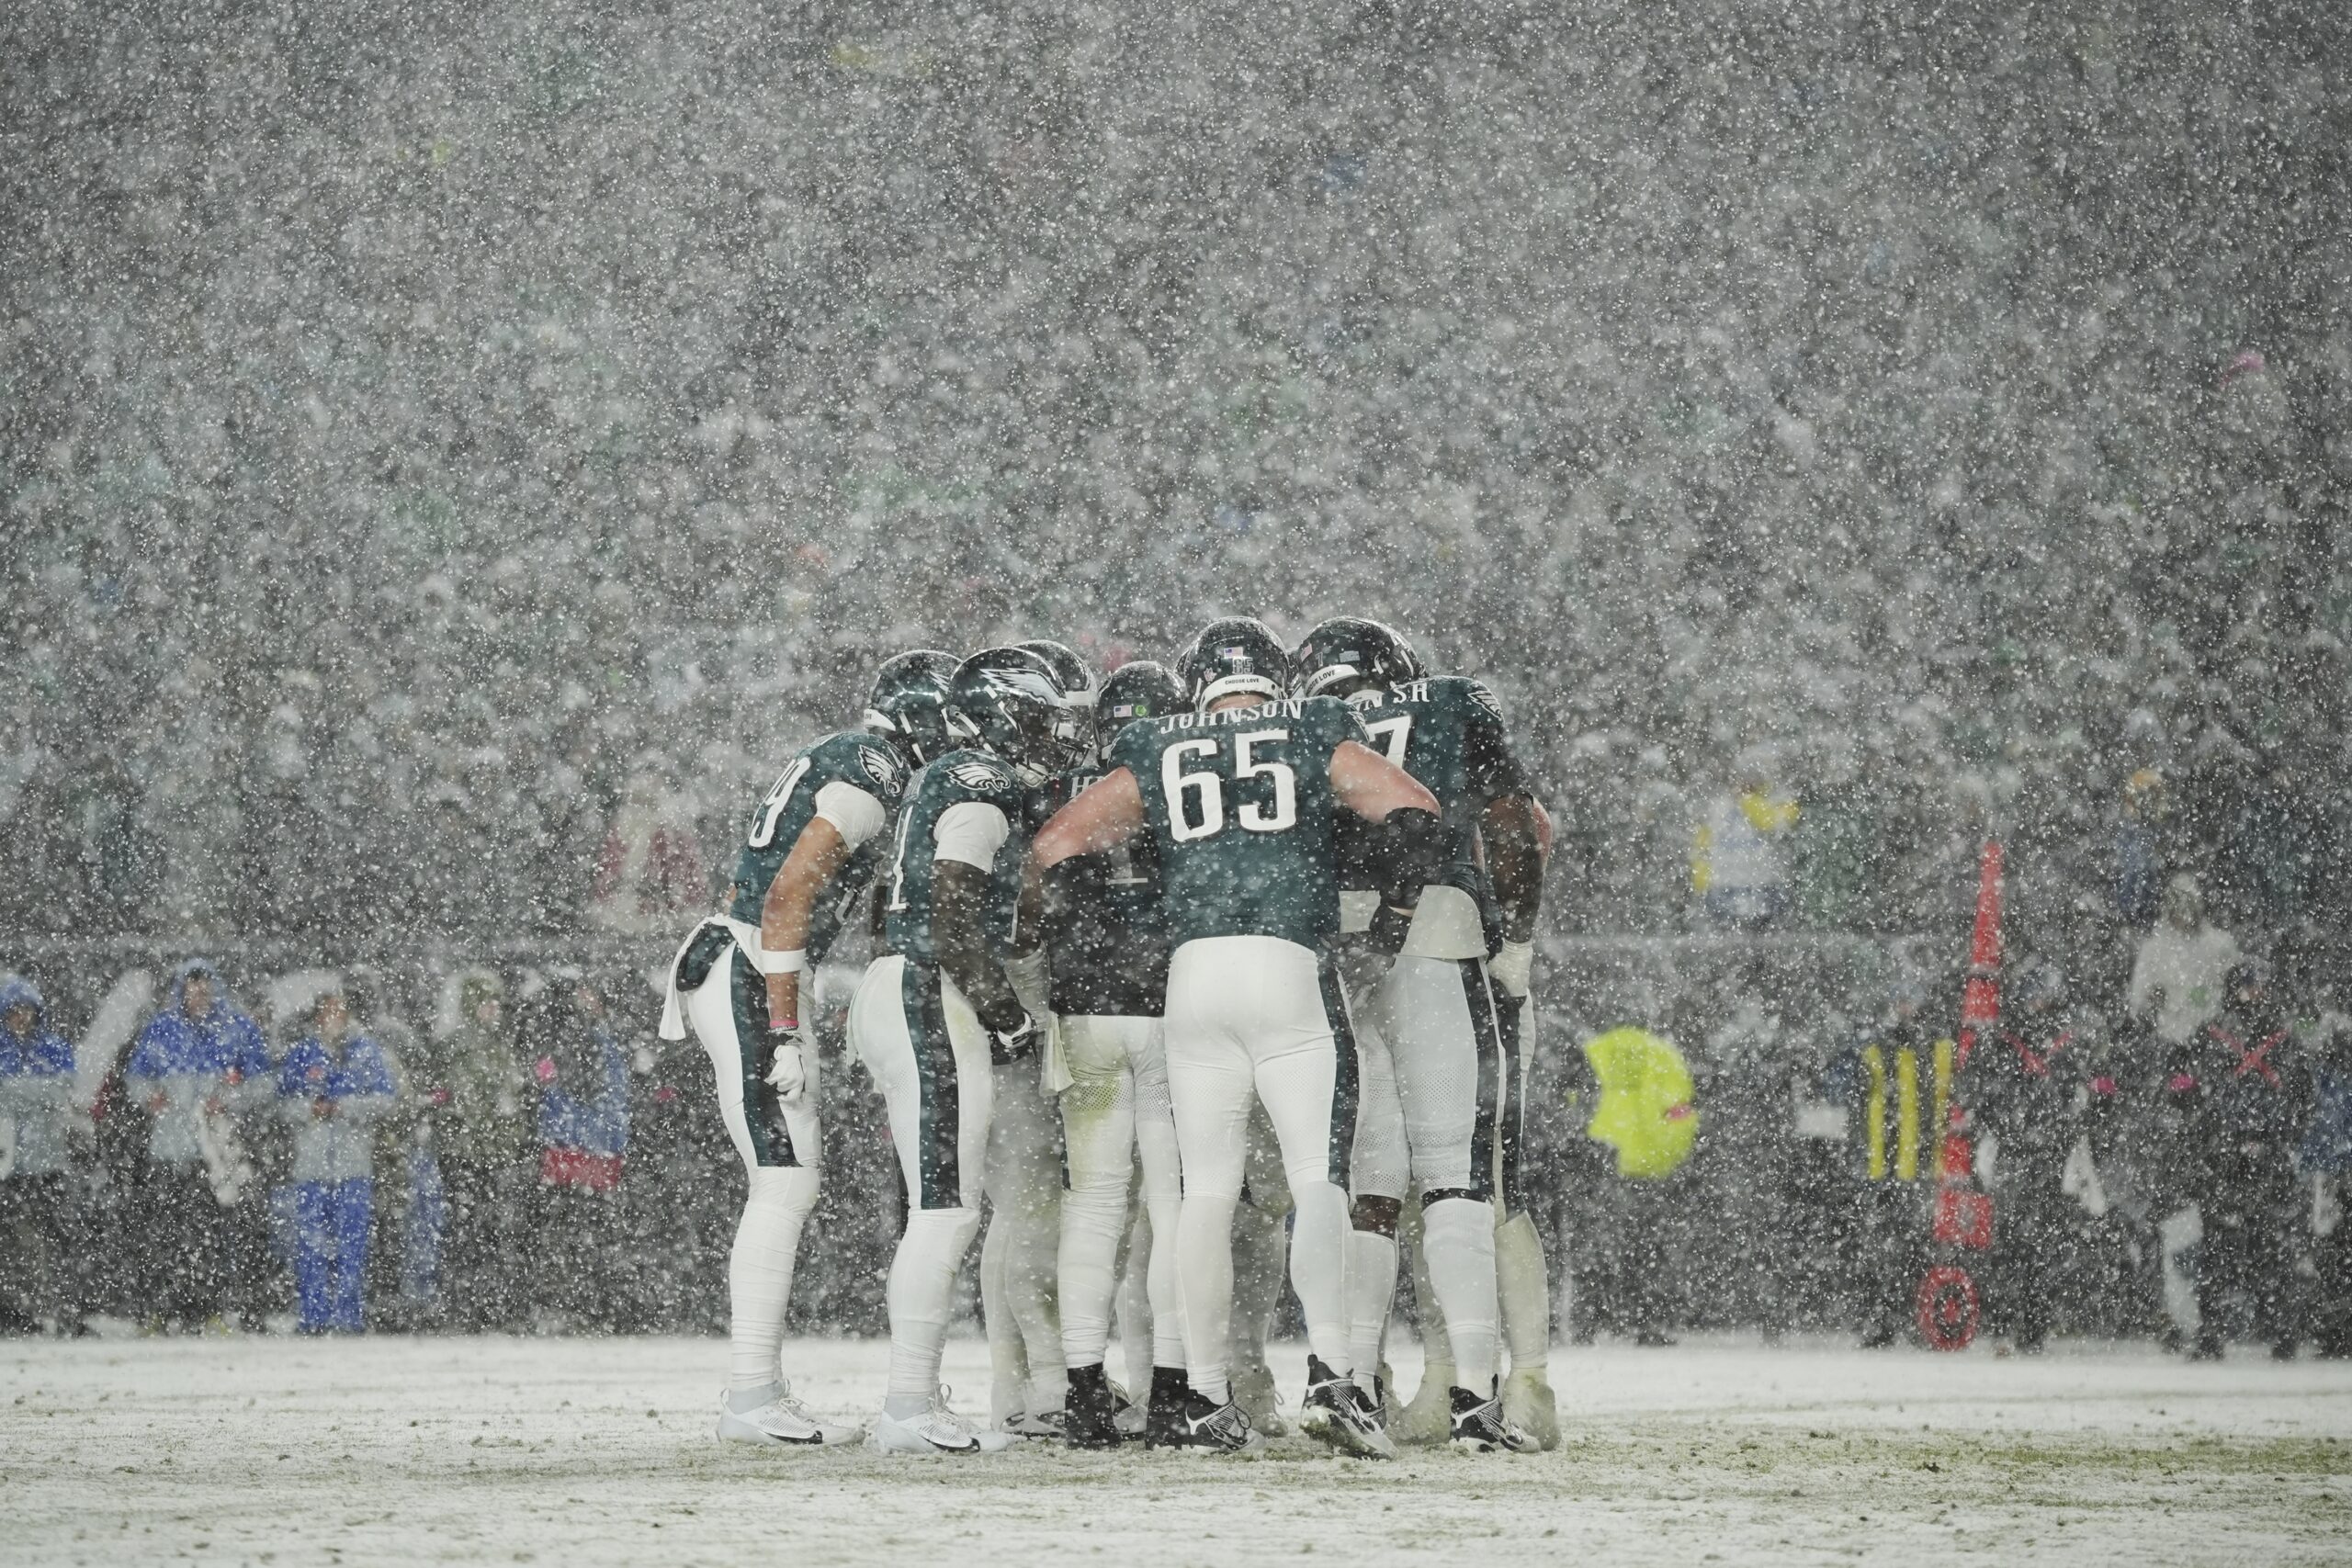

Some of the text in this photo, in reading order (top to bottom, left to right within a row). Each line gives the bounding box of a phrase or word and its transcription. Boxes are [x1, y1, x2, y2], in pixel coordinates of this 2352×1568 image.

[1392, 682, 1430, 704] SR
[1159, 699, 1303, 735] JOHNSON
[1161, 729, 1297, 842] 65
